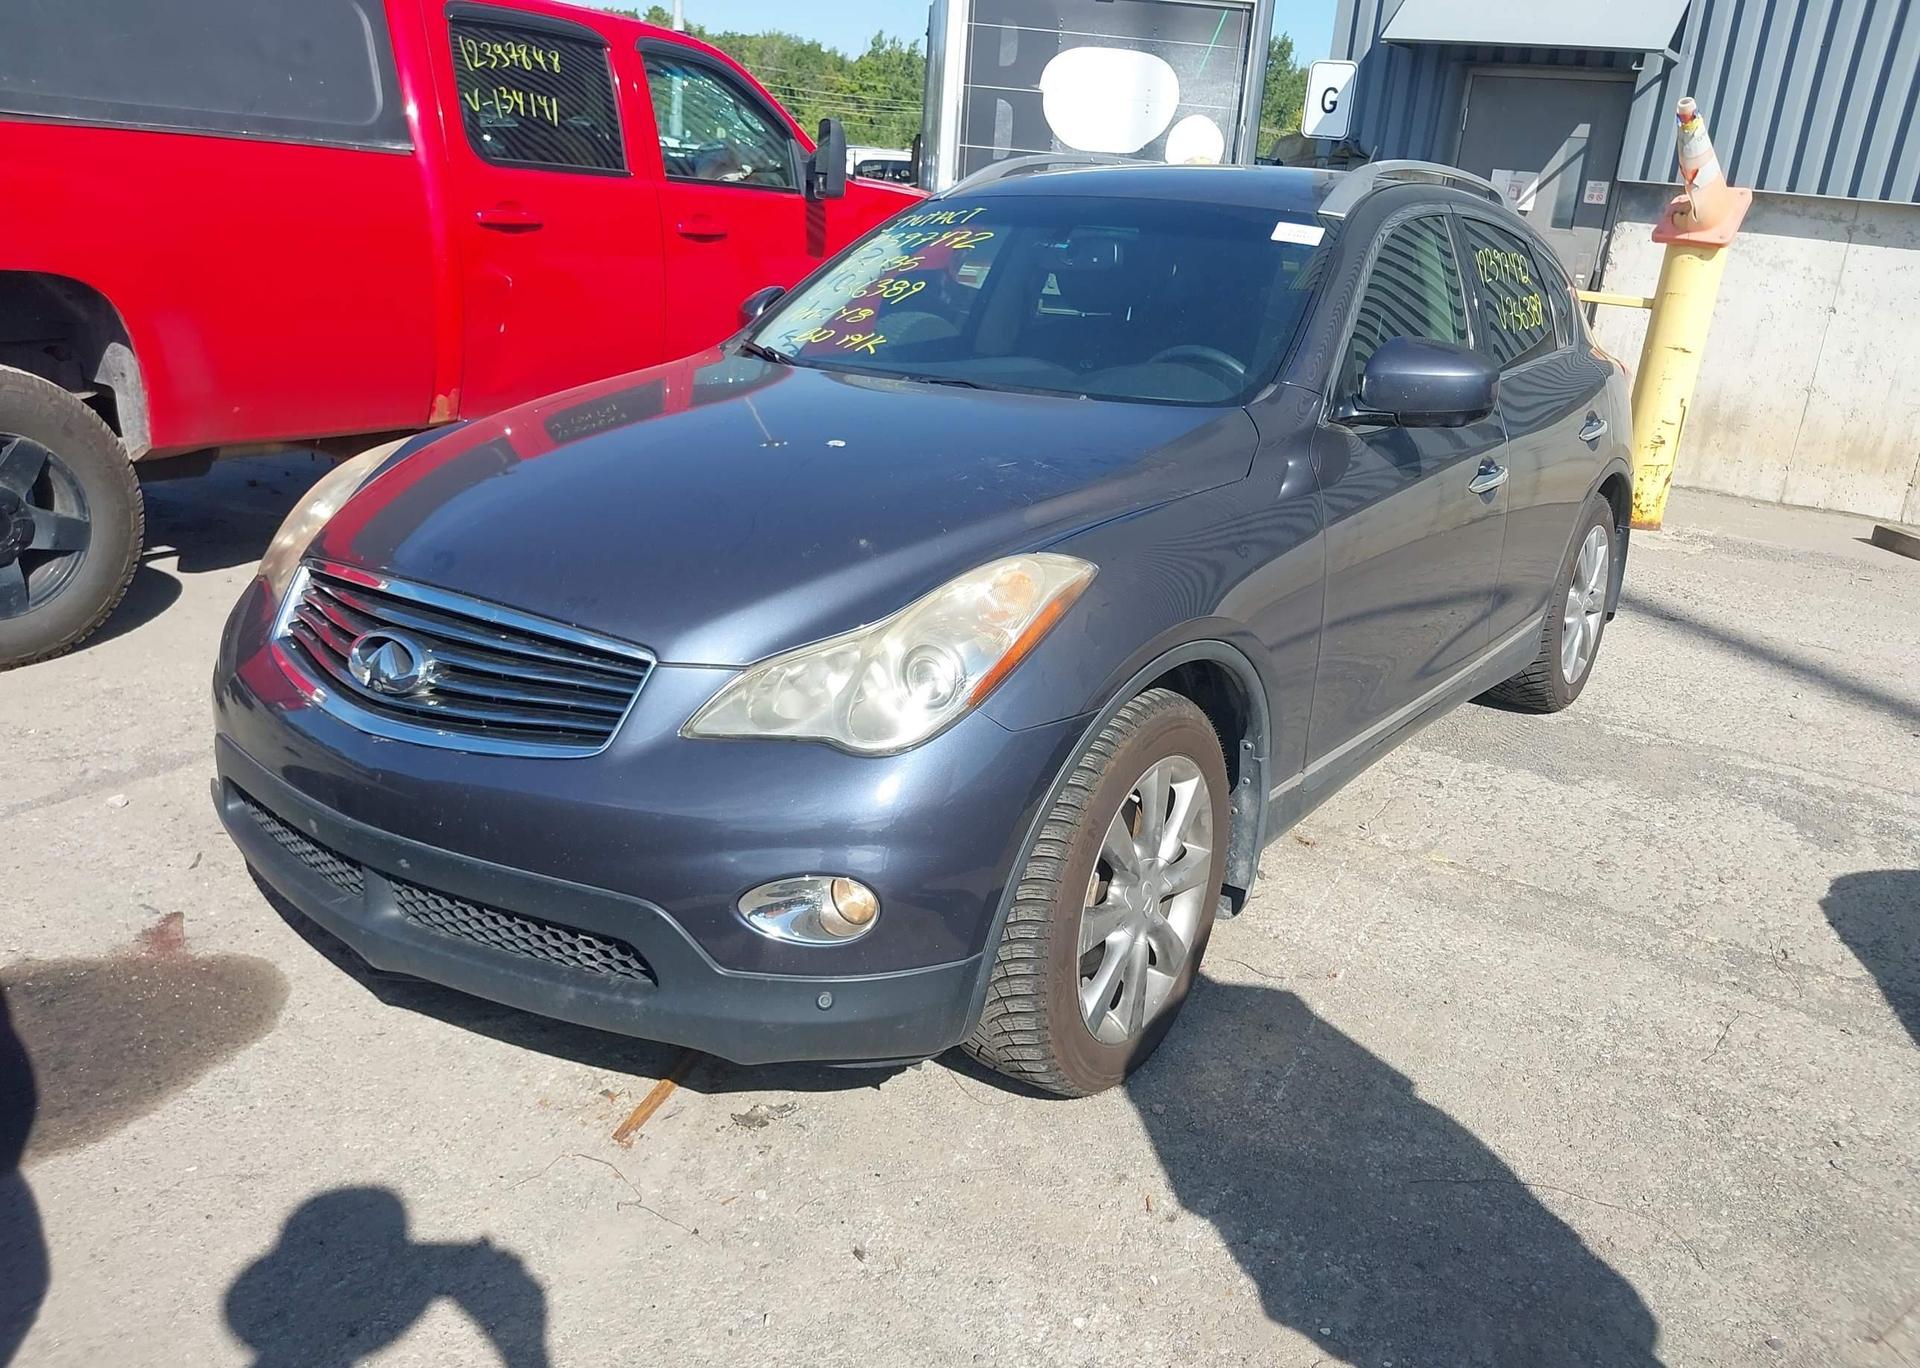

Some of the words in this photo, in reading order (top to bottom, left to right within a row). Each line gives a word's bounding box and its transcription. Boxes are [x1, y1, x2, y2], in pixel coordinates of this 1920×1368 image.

[459, 35, 561, 74] 12397848
[1321, 87, 1338, 114] G
[1475, 248, 1532, 289] 12397472
